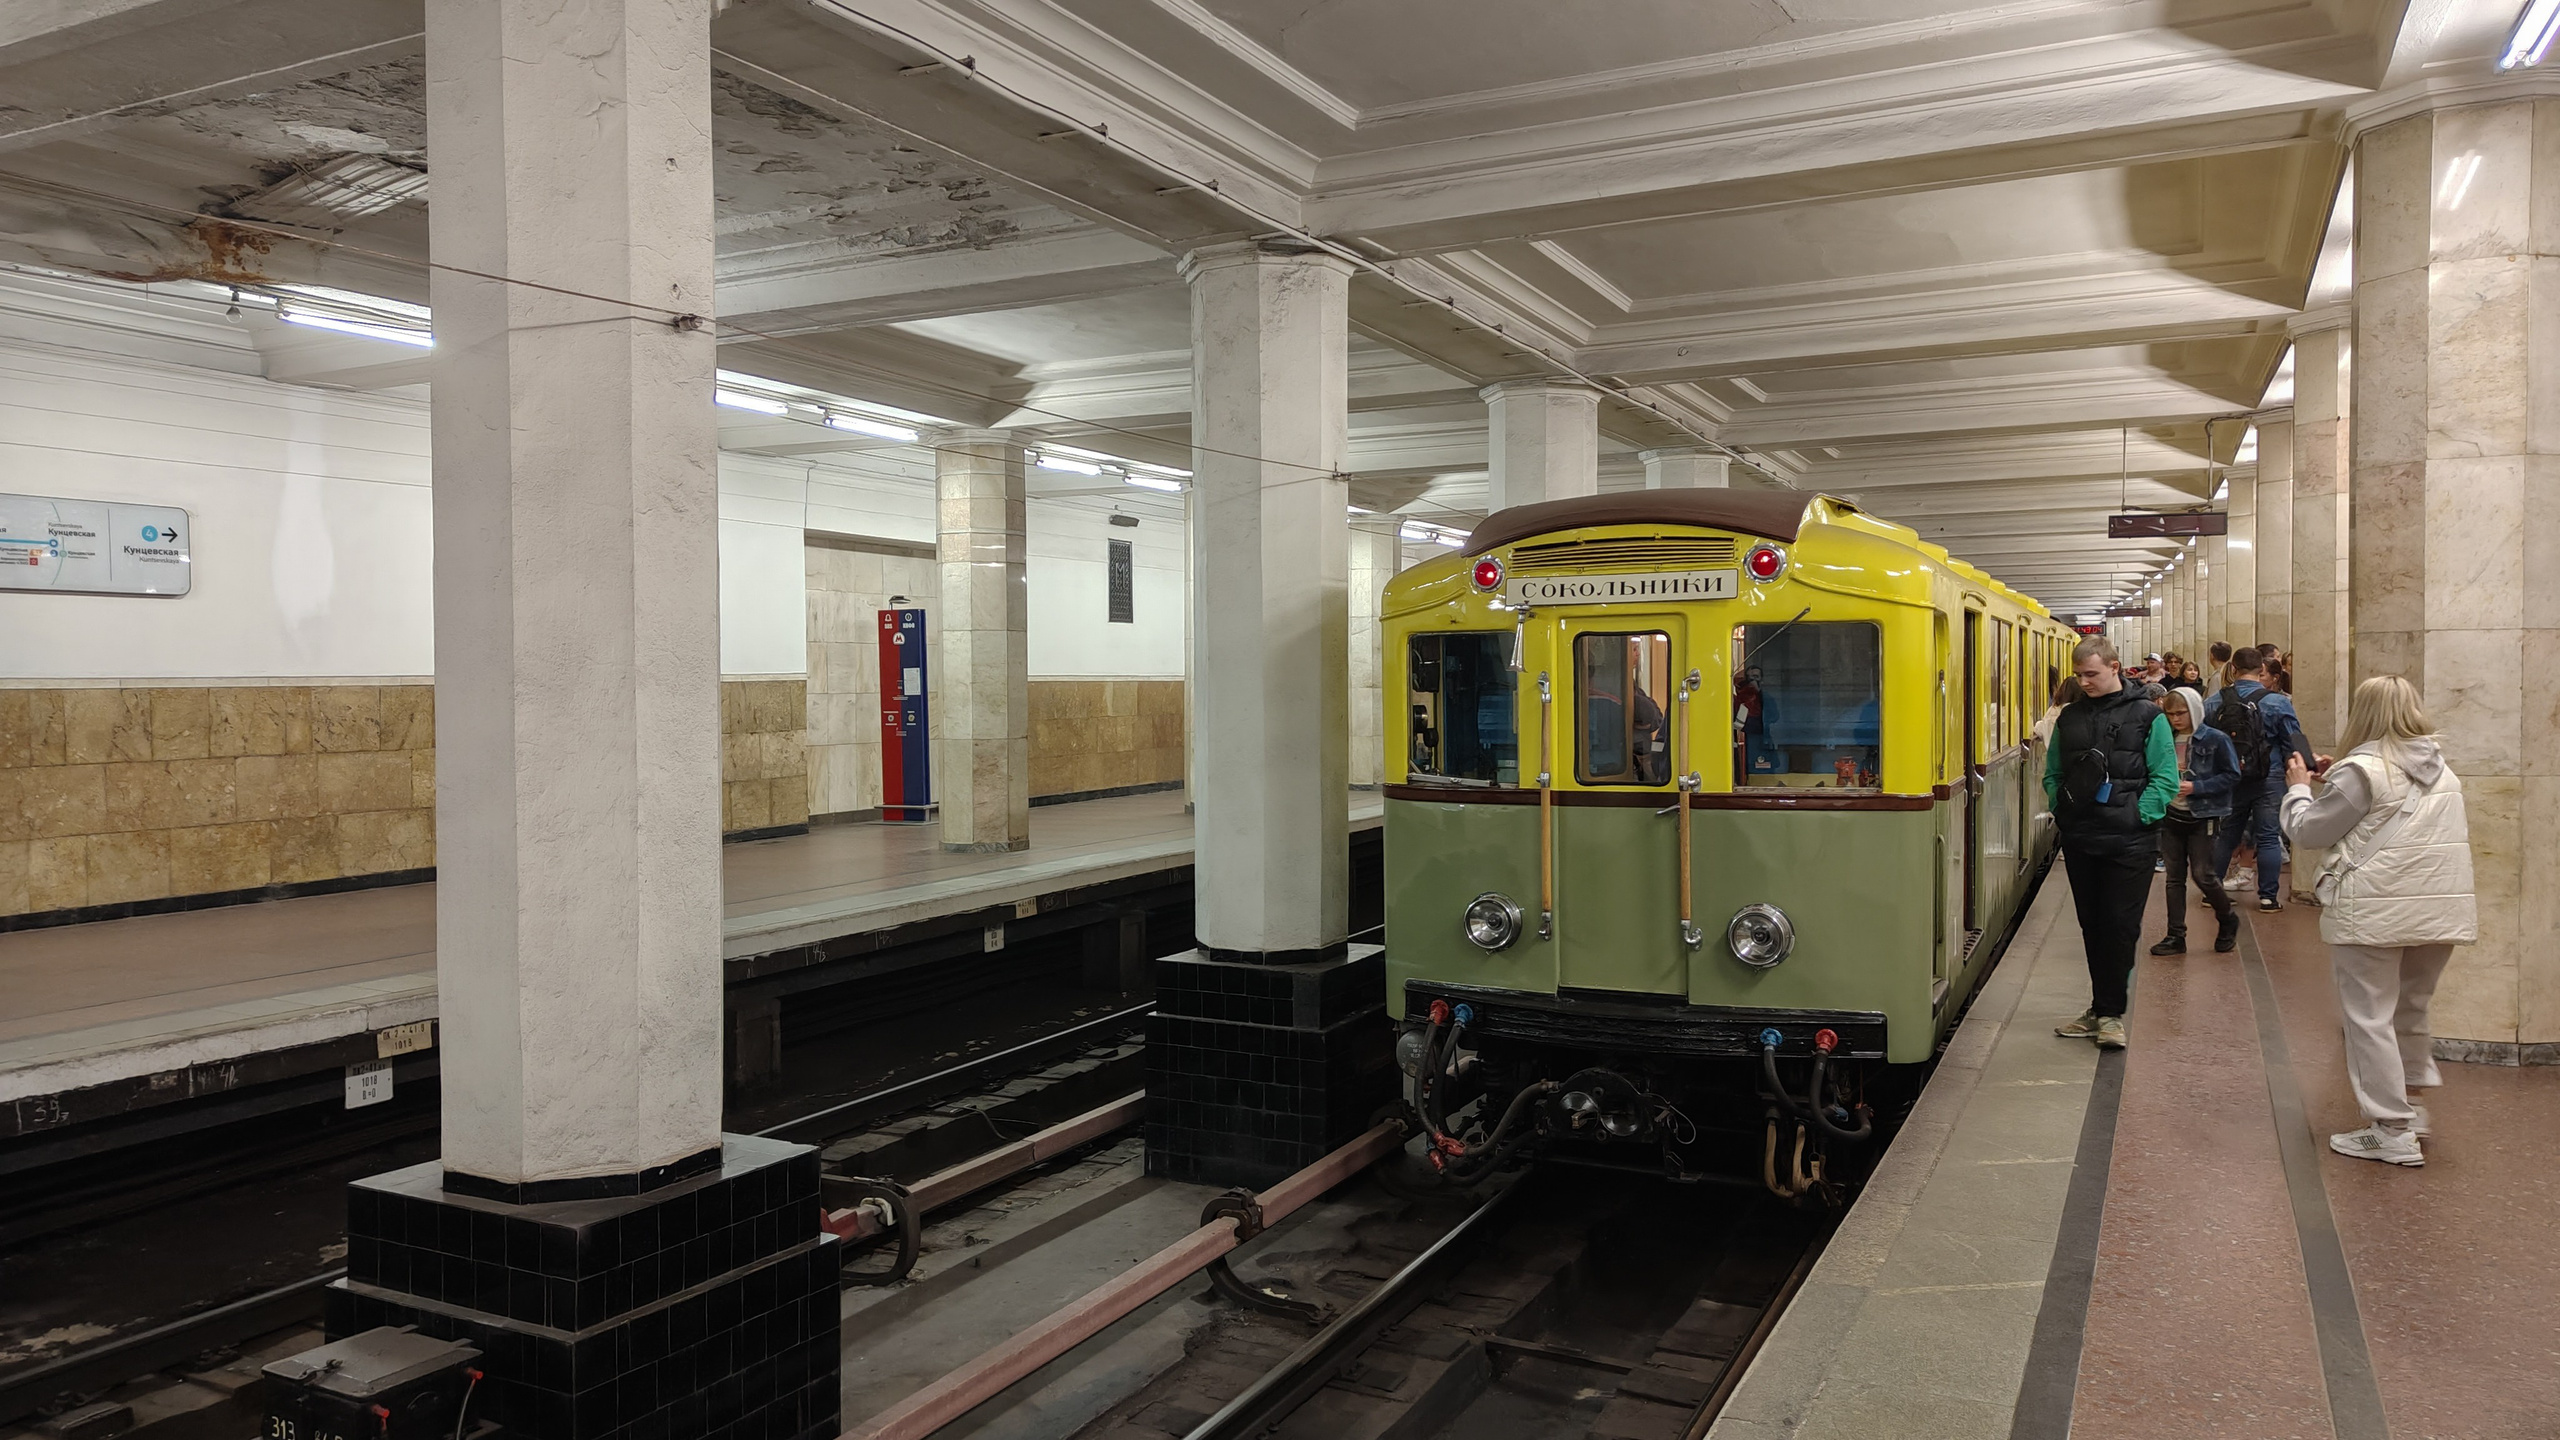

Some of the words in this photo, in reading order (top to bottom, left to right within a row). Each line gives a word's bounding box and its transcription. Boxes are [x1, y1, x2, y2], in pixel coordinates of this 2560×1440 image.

[48, 528, 96, 537] Кунцевская
[146, 529, 154, 539] 4
[123, 545, 179, 556] Кунцевская
[1521, 577, 1723, 599] СОКОЛЬНИКИ
[361, 1074, 378, 1087] 1018
